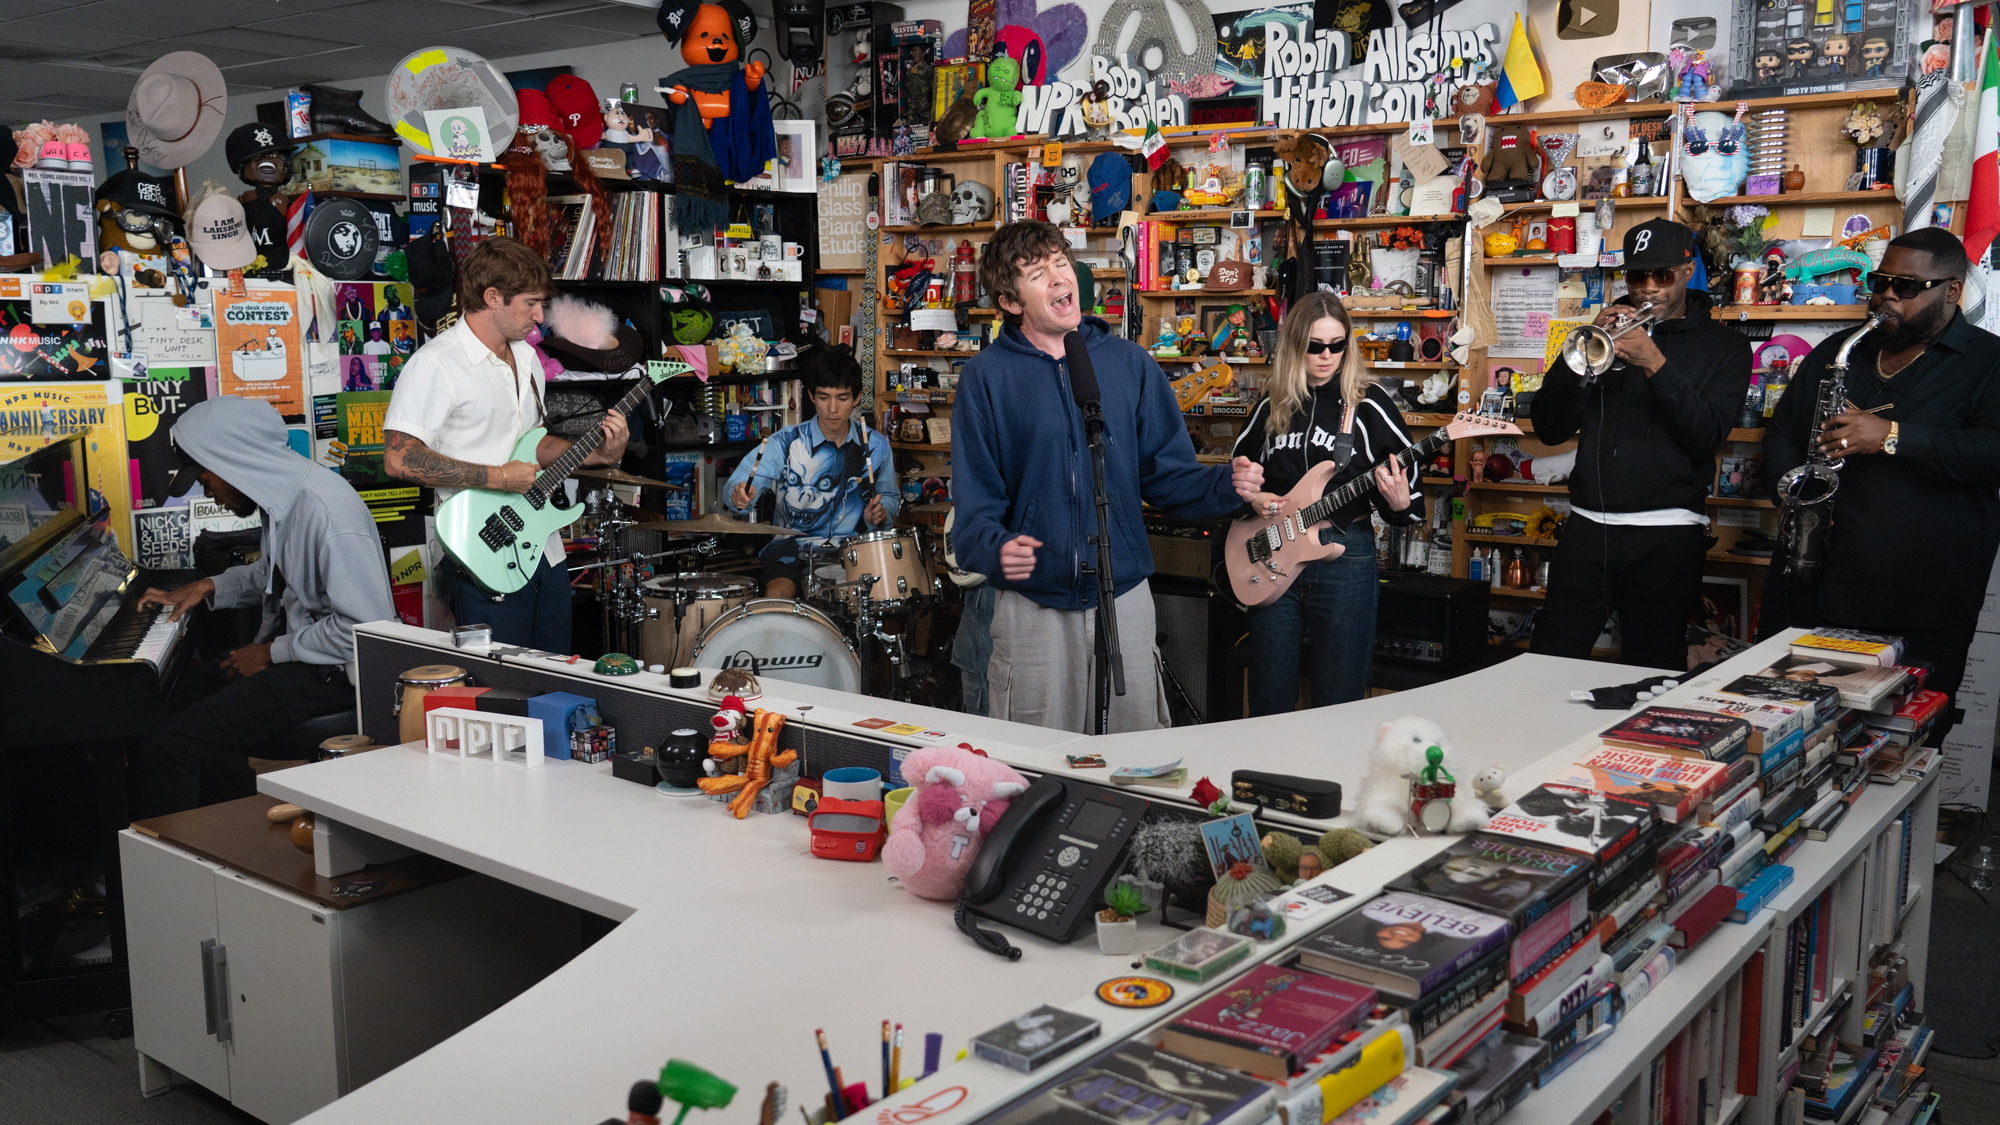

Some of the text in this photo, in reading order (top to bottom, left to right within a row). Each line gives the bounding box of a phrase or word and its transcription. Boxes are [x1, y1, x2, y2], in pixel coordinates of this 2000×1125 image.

[893, 25, 918, 34] MASTER
[1264, 20, 1345, 79] Robin
[1092, 53, 1143, 99] Bob
[1787, 84, 1843, 96] ZOO TV TOUR 1993
[1108, 78, 1188, 130] Boilen
[1263, 72, 1365, 129] Hilton
[1016, 80, 1090, 136] NPR
[569, 113, 581, 126] P
[1641, 122, 1663, 132] DESK
[836, 134, 867, 157] KISS
[39, 173, 55, 181] YOUNG
[56, 174, 78, 182] ARCHIVES
[1035, 172, 1057, 185] ASK
[412, 183, 438, 197] npr
[818, 179, 863, 200] Philip
[413, 199, 438, 213] music
[818, 199, 863, 216] Glass
[203, 220, 243, 234] LAKSHMI
[220, 218, 235, 226] AM
[819, 216, 866, 235] Piano
[211, 229, 239, 240] SINGH
[820, 235, 868, 254] Etude
[1633, 229, 1652, 255] B
[1218, 267, 1239, 278] Don't
[1219, 276, 1239, 285] Trip
[34, 285, 61, 294] npr
[927, 288, 937, 300] n
[226, 310, 290, 321] CONTEST
[28, 336, 61, 346] MUSIC
[149, 336, 204, 345] TINY DESK
[164, 345, 187, 353] UNIT
[135, 376, 185, 396] TINY
[5, 392, 71, 406] NPR MUSIC
[134, 396, 187, 416] BUT-
[1213, 407, 1246, 415] BROCCOLI
[1463, 425, 1501, 436] Jackson
[401, 489, 418, 497] FRIEND.
[139, 513, 176, 530] NICK
[141, 541, 189, 556] SEEDS
[399, 561, 423, 579] NPR
[436, 716, 524, 754] npr
[1596, 751, 1712, 775] MADE MUSIC
[1586, 758, 1702, 783] HOW WOMEN
[1485, 825, 1515, 834] THE
[1491, 819, 1540, 833] HARD
[1496, 816, 1548, 829] STUFF
[950, 834, 970, 860] T
[1472, 840, 1583, 867] BROTHER
[1480, 850, 1578, 875] DREAM
[1371, 901, 1481, 936] BELIEVE
[1559, 980, 1589, 1020] OZZY
[1423, 989, 1477, 1036] THE WHO FAQ
[1237, 1020, 1306, 1042] Jazz
